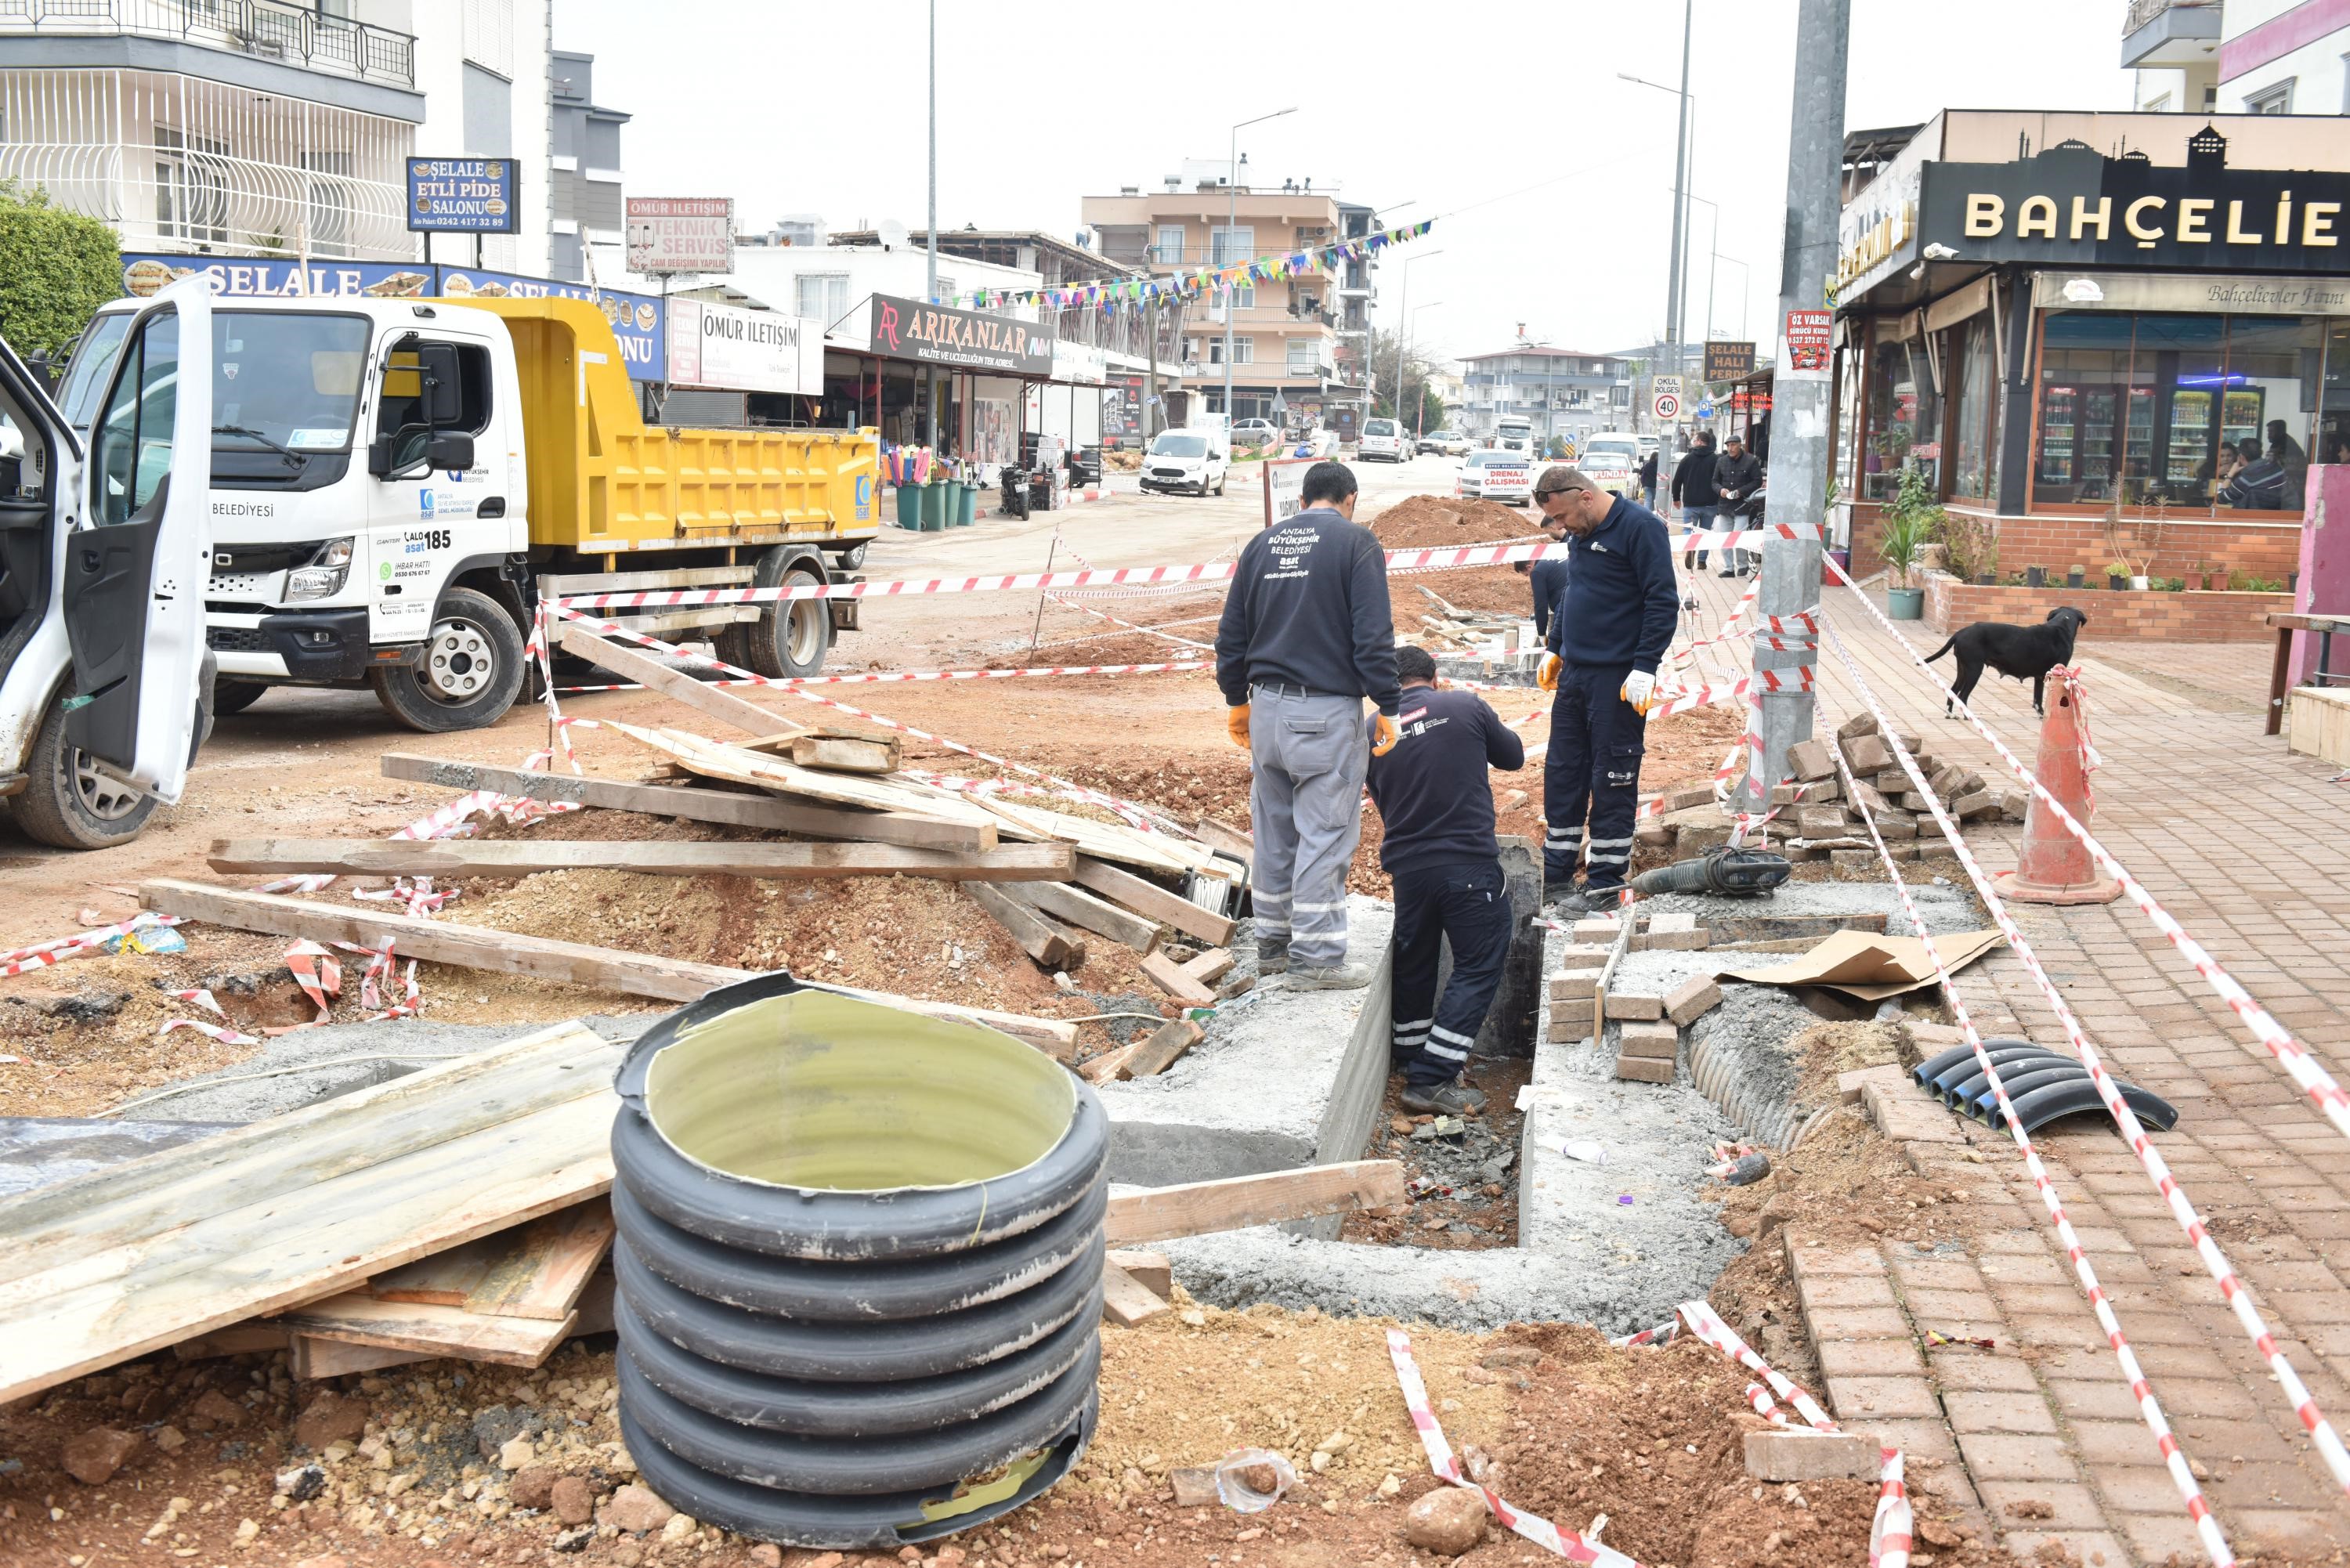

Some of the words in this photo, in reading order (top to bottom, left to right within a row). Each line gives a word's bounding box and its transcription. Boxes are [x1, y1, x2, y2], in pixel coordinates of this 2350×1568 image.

[431, 162, 484, 181] ŞELALE
[417, 179, 456, 197] ETLİ
[459, 179, 501, 197] PİDE
[432, 201, 486, 215] SALONU
[631, 201, 669, 214] ÖMÜR
[673, 201, 725, 216] İLETİŞİM
[1965, 190, 2341, 249] BAHÇELİE
[651, 258, 666, 267] CAM
[700, 258, 726, 268] YAPILIR
[2208, 284, 2300, 306] Bahçelievler
[1791, 313, 1802, 325] ÖZ
[1804, 315, 1830, 326] VARSAK
[704, 309, 743, 341] ÖMÜR
[748, 315, 797, 352] İLETİŞİM
[906, 309, 1026, 360] ARIKANLAR
[1789, 327, 1812, 335] SÜRÜCÜ
[918, 347, 940, 359] KALİTE
[940, 351, 949, 360] VE
[949, 352, 984, 365] UCUZLUĞUN
[984, 356, 995, 366] TEK
[1708, 345, 1752, 357] ŞELALE
[1714, 356, 1744, 367] HALI
[1660, 400, 1674, 413] 40
[212, 501, 273, 517] BELEDİYESİ
[410, 532, 424, 540] ALO
[424, 529, 451, 550] 185
[1268, 533, 1320, 546] BÜYÜKŞEHİR
[405, 542, 425, 553] asat
[1271, 544, 1311, 555] BELEDİYESİ
[1279, 556, 1300, 565] asat
